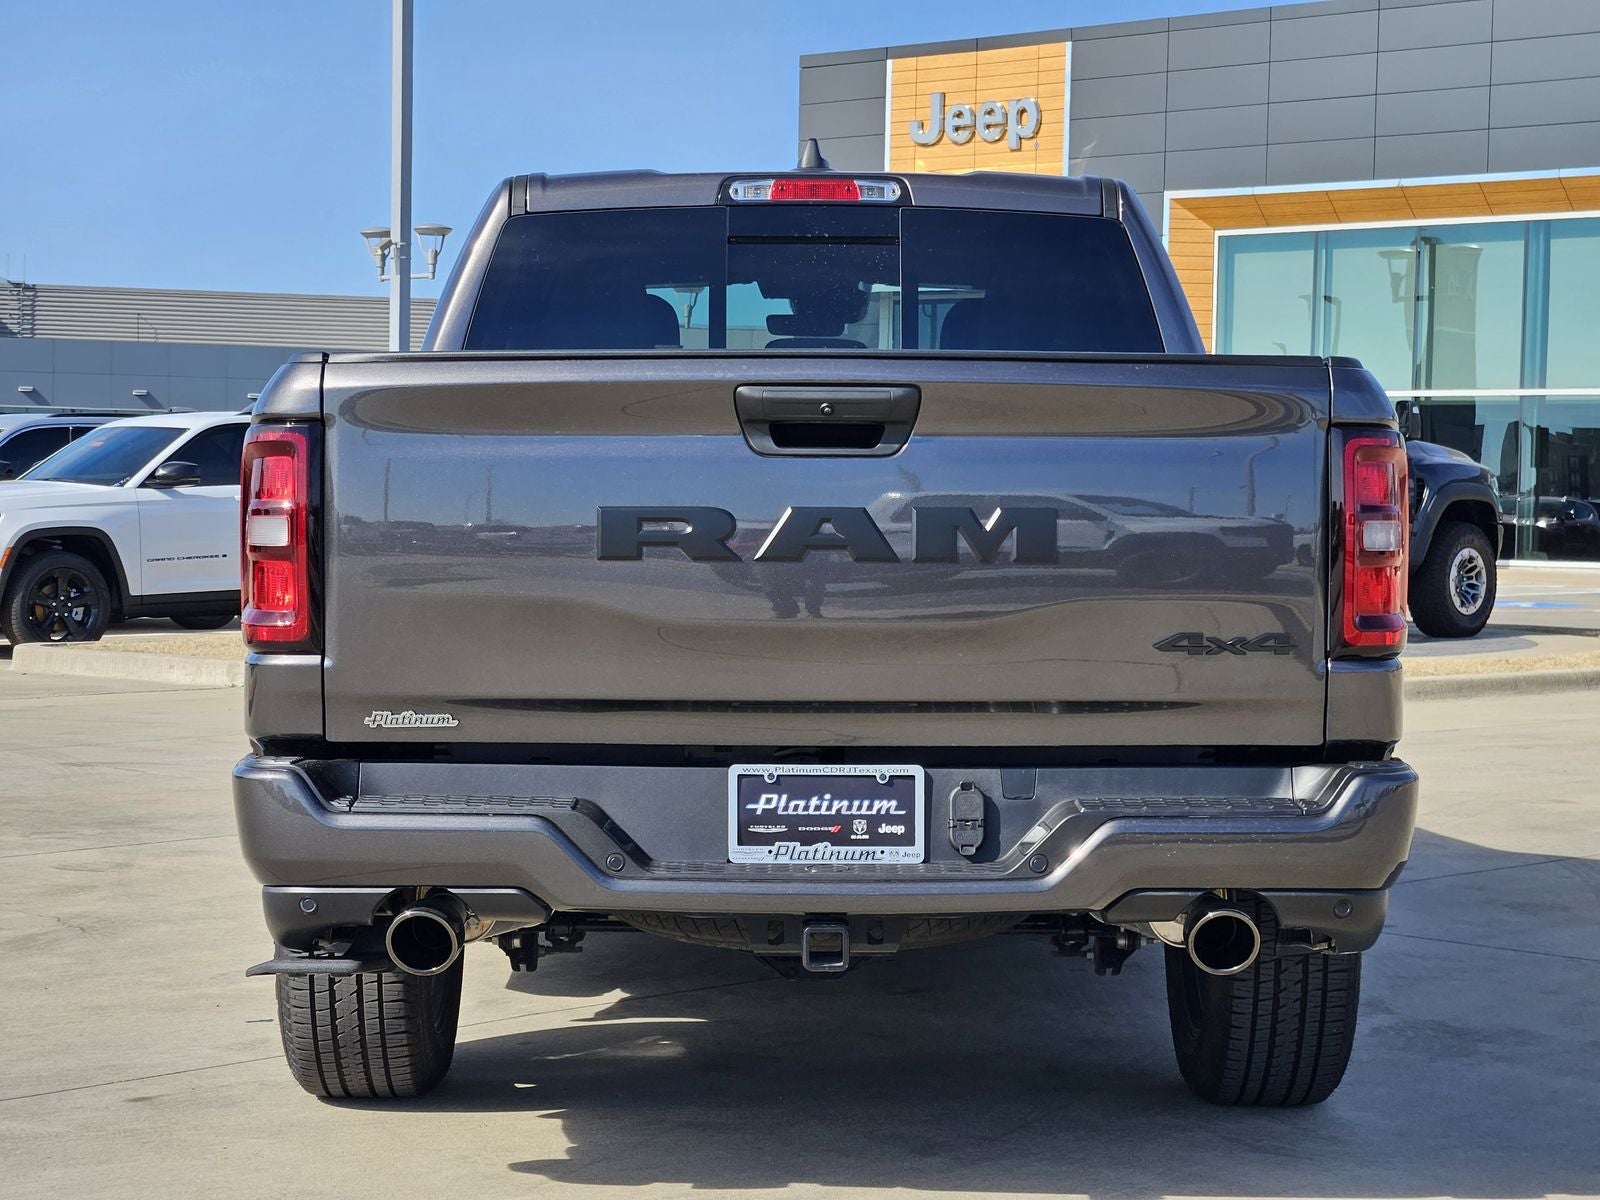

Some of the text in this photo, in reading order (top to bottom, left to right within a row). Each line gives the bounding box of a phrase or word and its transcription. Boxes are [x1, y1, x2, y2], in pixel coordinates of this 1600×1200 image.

[909, 92, 1041, 151] Jeep
[596, 506, 1059, 562] RAM
[364, 711, 459, 728] Platinum
[742, 766, 909, 774] www.PlatinumCDRJTexas.com
[745, 794, 906, 815] Platinum
[878, 823, 905, 835] Jeep
[774, 845, 882, 861] Platinum
